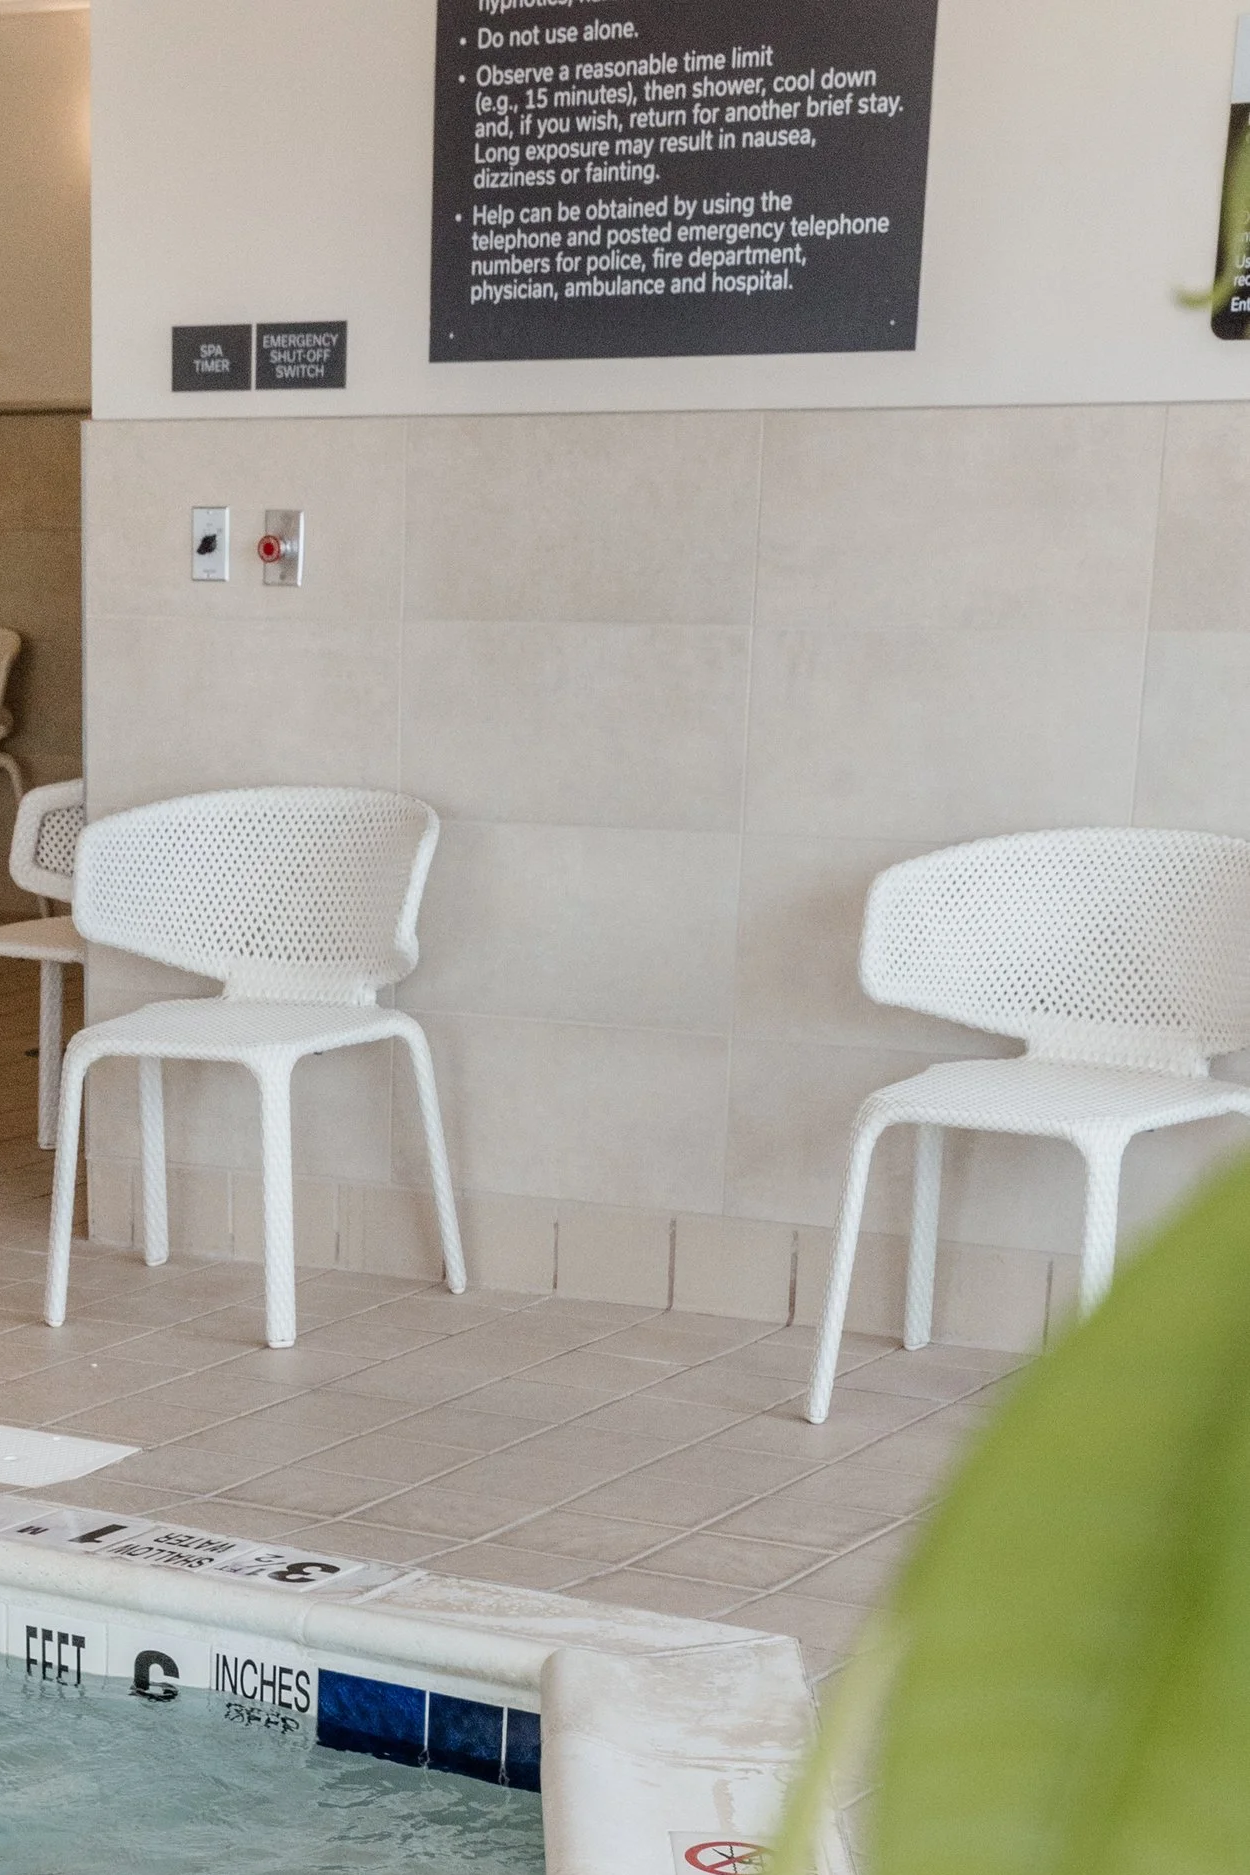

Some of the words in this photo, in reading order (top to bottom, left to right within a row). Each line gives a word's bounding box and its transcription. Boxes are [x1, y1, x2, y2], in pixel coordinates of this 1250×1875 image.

[477, 28, 503, 49] Do
[509, 26, 540, 47] not
[545, 26, 578, 44] use
[583, 19, 639, 42] alone.
[476, 65, 553, 87] Observe
[559, 65, 569, 81] a
[575, 52, 677, 79] reasonable
[683, 50, 726, 73] time
[732, 45, 773, 69] limit
[475, 91, 518, 116] (e.g.,
[525, 88, 548, 110] 15
[554, 81, 637, 108] minutes),
[644, 80, 686, 101] then
[692, 76, 766, 99] shower,
[773, 68, 815, 92] cool
[821, 67, 876, 89] down
[475, 116, 513, 140] and,
[520, 114, 532, 135] if
[537, 117, 570, 139] you
[576, 110, 623, 133] wish,
[629, 108, 686, 129] return
[693, 103, 720, 125] for
[725, 98, 800, 123] another
[807, 93, 853, 118] brief
[858, 93, 904, 117] stay.
[474, 143, 519, 166] Long
[526, 139, 609, 164] exposure
[615, 138, 654, 158] may
[659, 129, 713, 153] result
[718, 128, 735, 149] in
[742, 127, 816, 148] nausea,
[473, 167, 556, 189] dizziness
[560, 167, 580, 185] or
[585, 160, 660, 184] fainting.
[472, 204, 514, 228] Help
[519, 206, 551, 224] can
[557, 201, 580, 222] be
[585, 195, 668, 220] obtained
[674, 195, 697, 220] by
[702, 193, 755, 217] using
[761, 190, 793, 212] the
[472, 229, 562, 253] telephone
[567, 224, 601, 247] and
[607, 221, 672, 249] posted
[677, 220, 785, 245] emergency
[790, 214, 890, 239] telephone
[471, 254, 550, 276] numbers
[555, 251, 581, 272] for
[587, 249, 646, 276] police,
[652, 247, 683, 269] fire
[688, 244, 806, 270] department,
[470, 279, 558, 305] physician,
[565, 274, 665, 298] ambulance
[671, 272, 705, 294] and
[712, 268, 793, 295] hospital.
[200, 344, 223, 357] SPA
[263, 334, 339, 348] EMERGENCY
[194, 359, 230, 373] TIMER
[270, 349, 331, 364] SHUT-OFF
[275, 365, 324, 379] SWITCH
[68, 1524, 129, 1543] 1
[153, 1532, 236, 1553] WATER
[108, 1543, 214, 1569] SHALLOW
[216, 1653, 310, 1713] INCHES
